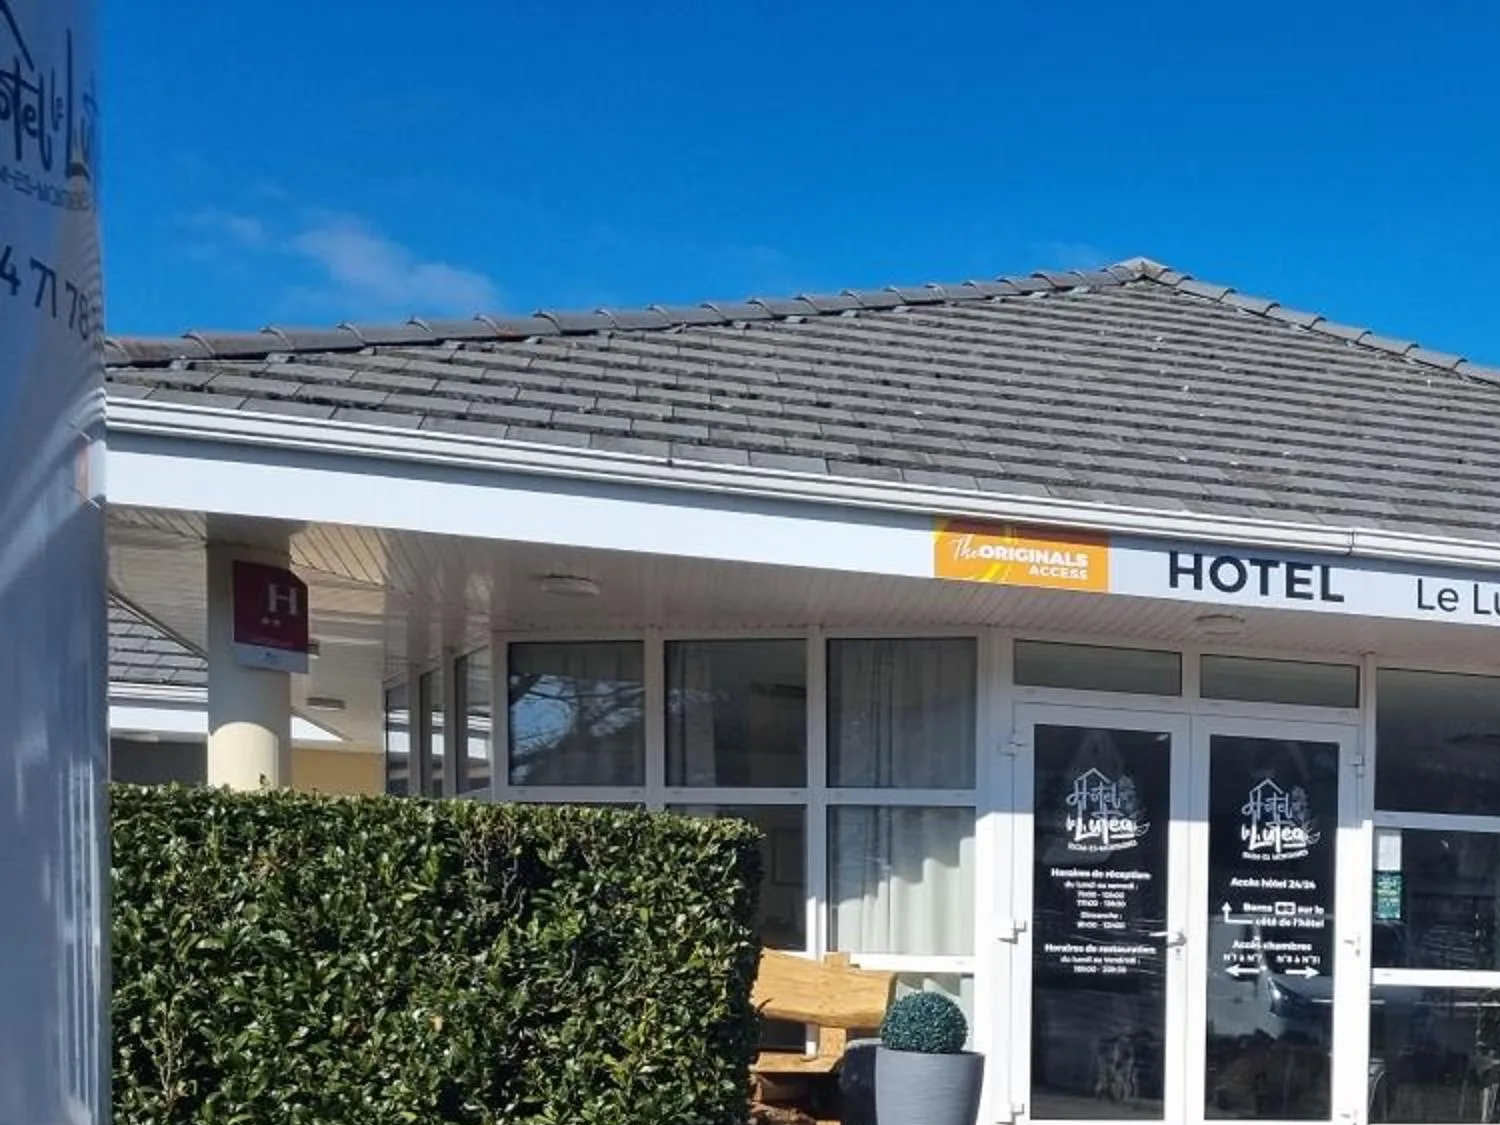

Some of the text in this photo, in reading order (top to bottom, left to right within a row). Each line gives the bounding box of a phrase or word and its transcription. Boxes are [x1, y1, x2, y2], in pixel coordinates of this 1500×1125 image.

[30, 256, 57, 318] 71
[65, 279, 89, 340] 78
[978, 545, 1089, 567] ORIGINALS
[1028, 565, 1089, 580] ACCESS
[1169, 551, 1345, 603] HOTEL
[1417, 578, 1459, 612] Le
[268, 583, 298, 616] H
